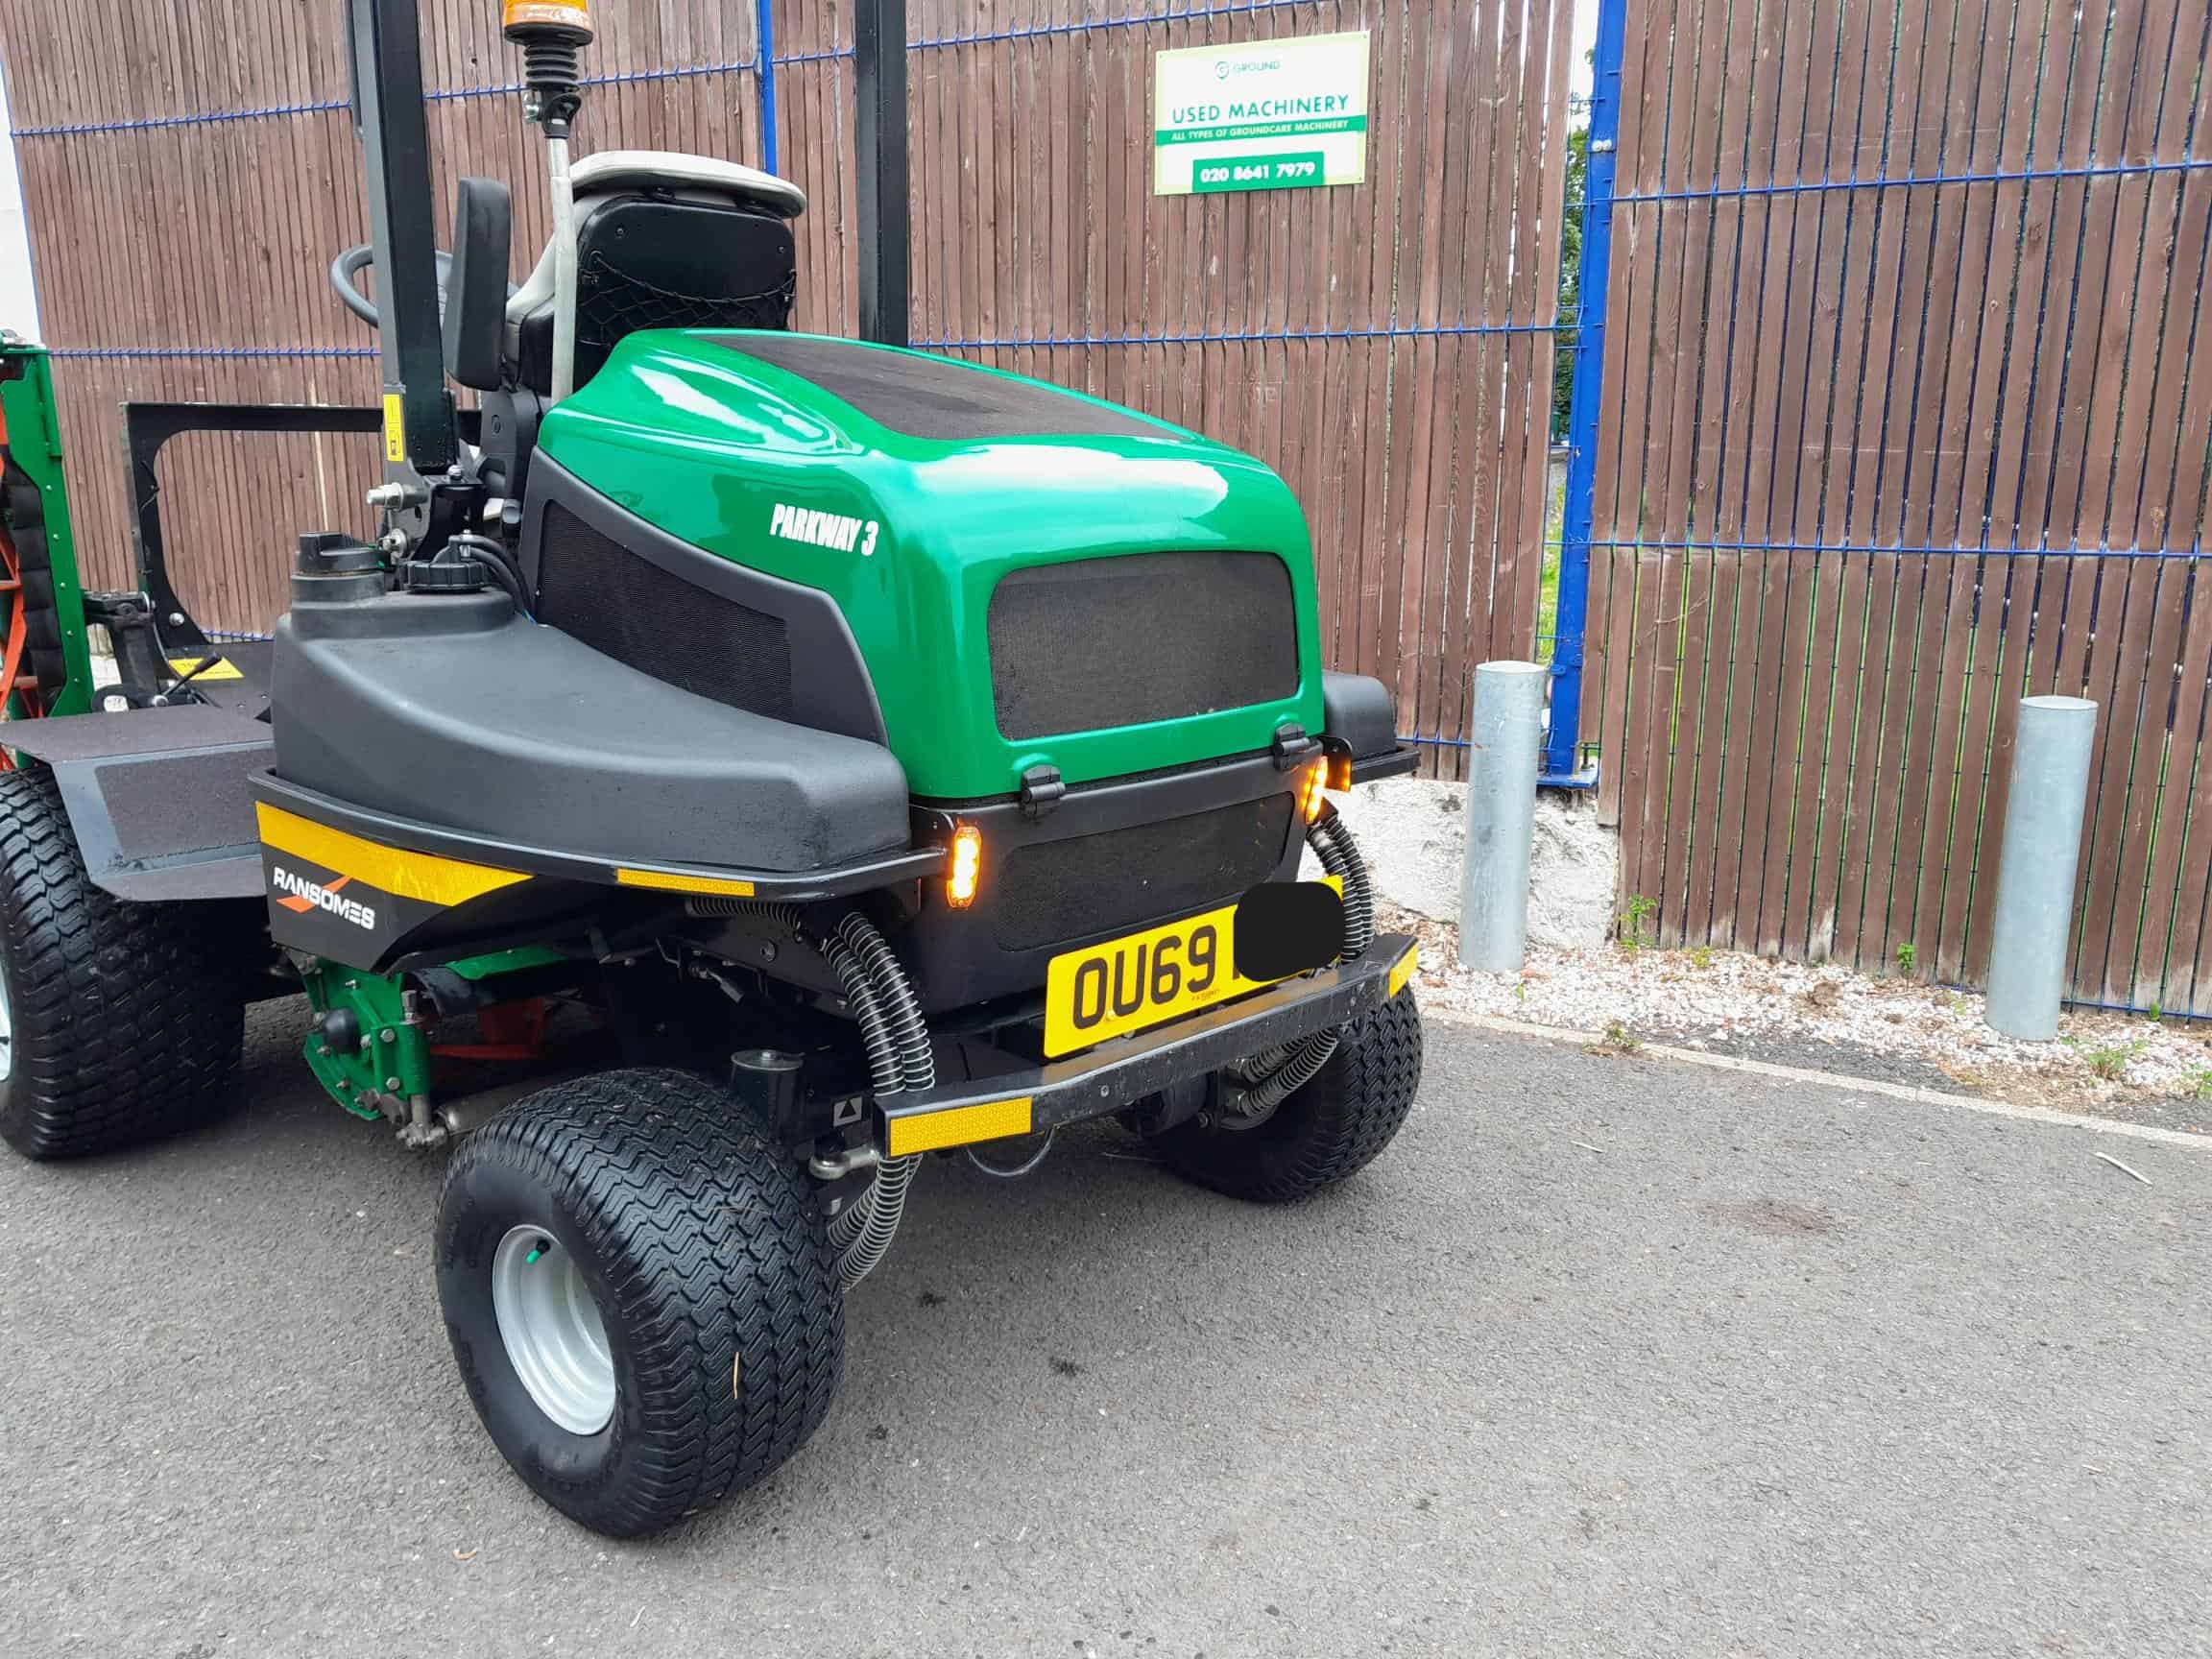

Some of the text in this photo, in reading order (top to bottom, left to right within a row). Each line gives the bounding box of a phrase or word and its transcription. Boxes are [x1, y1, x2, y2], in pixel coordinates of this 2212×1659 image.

[1172, 94, 1349, 123] USED MACHINERY
[1171, 120, 1349, 141] ALL TYPES OF GROUNDCARE MACHINERY
[1200, 161, 1316, 182] 020 8641 7979
[770, 503, 879, 557] PARKWAY 3
[274, 866, 376, 930] RANSOMES
[1072, 925, 1216, 1030] OU69
